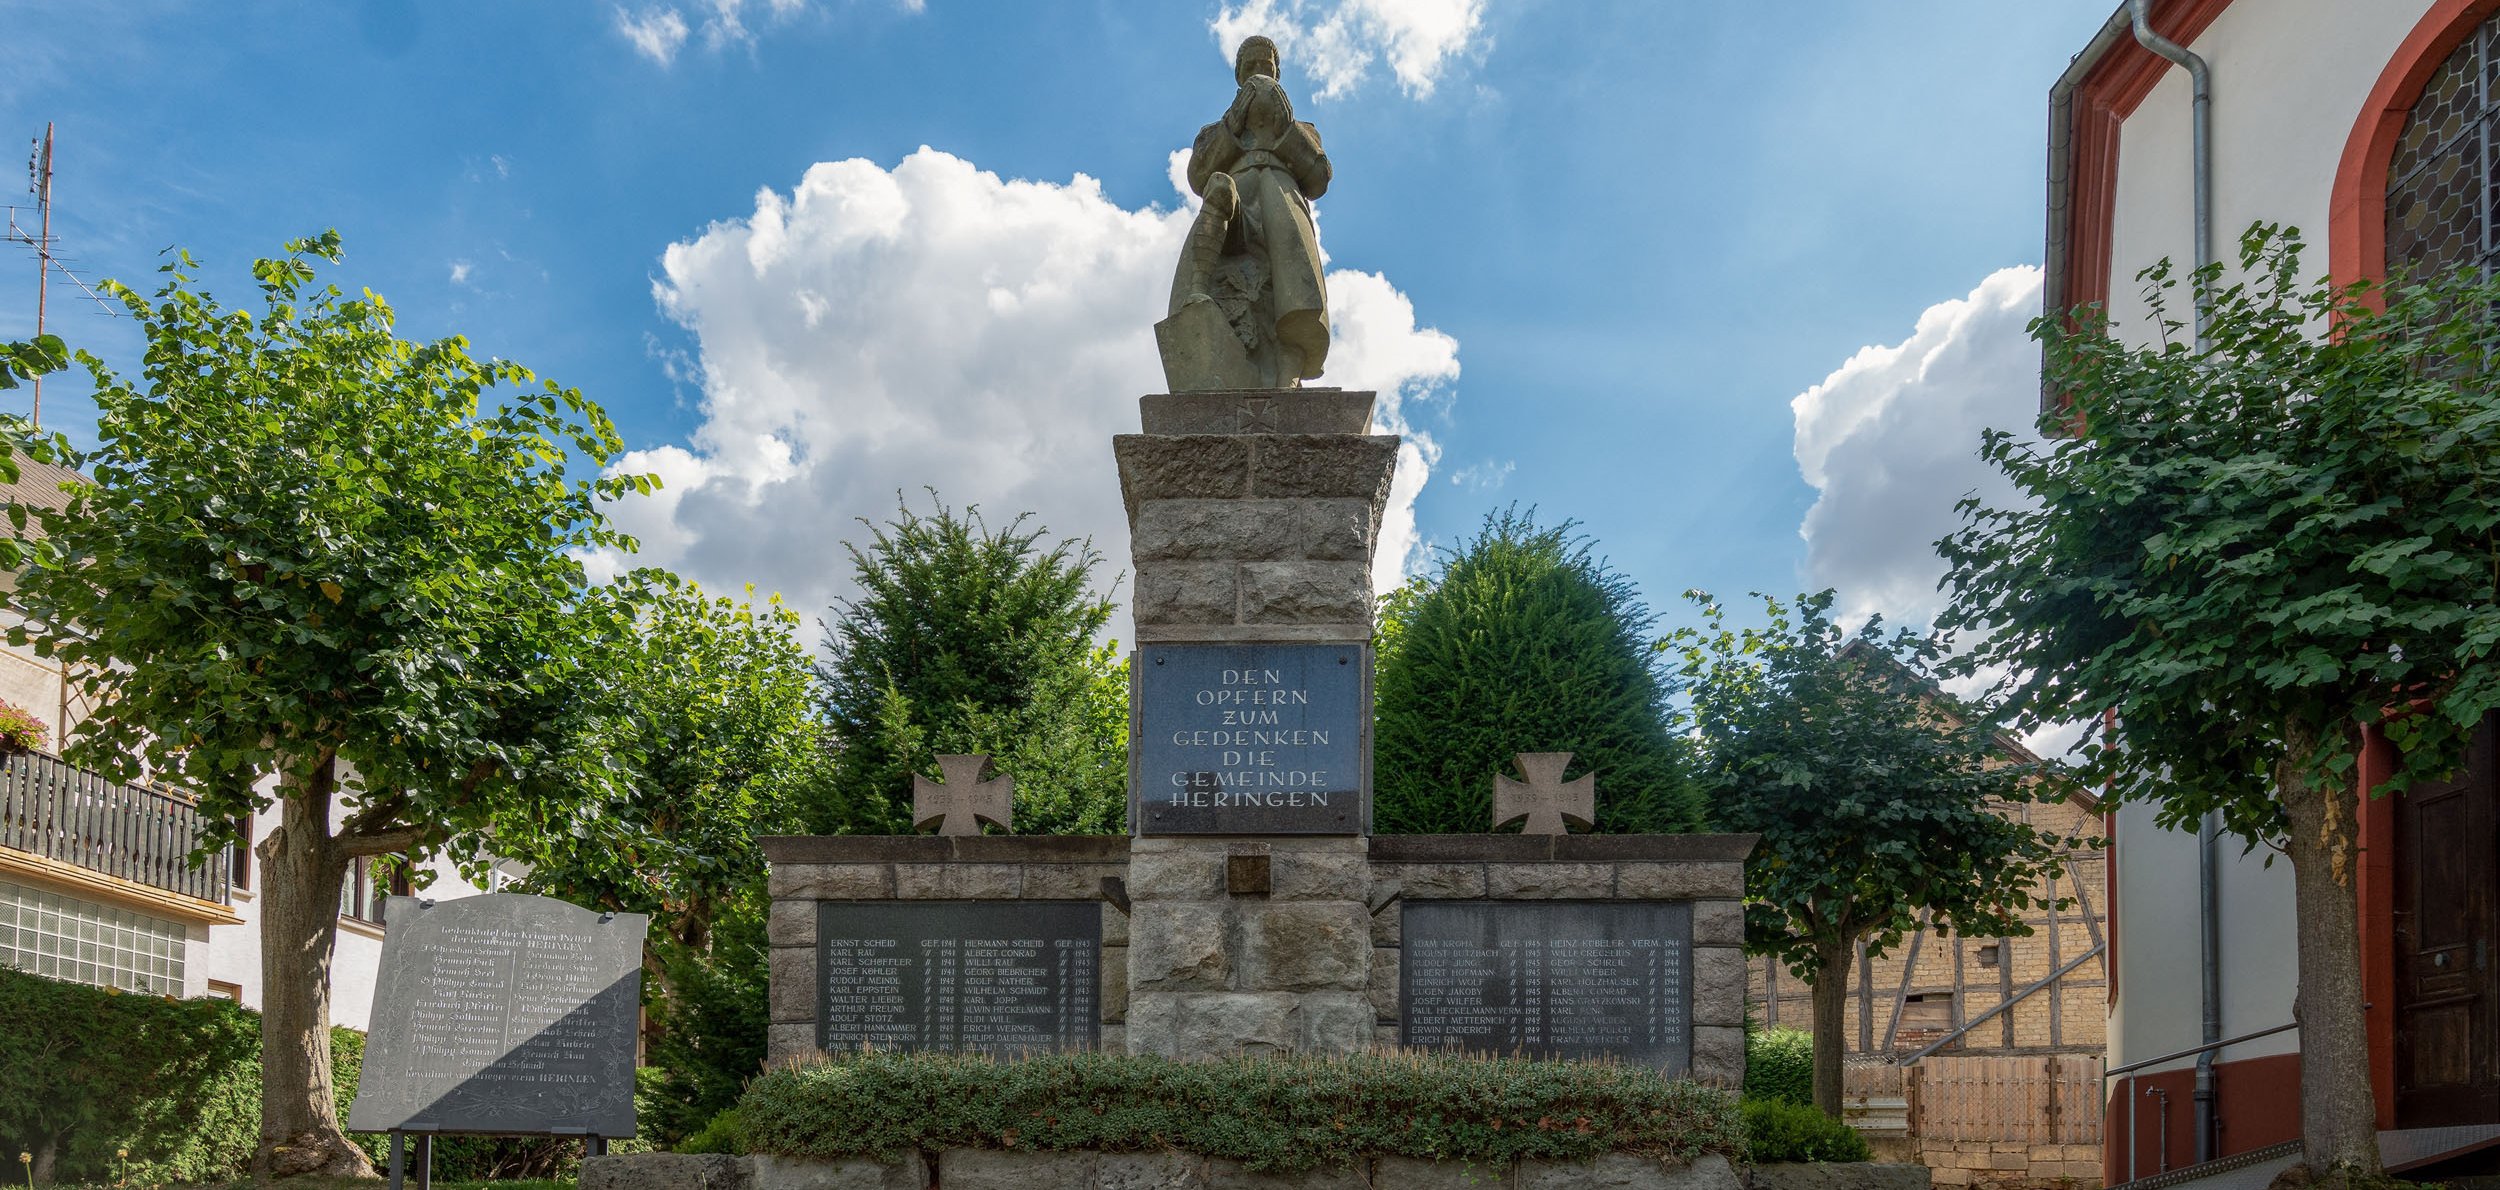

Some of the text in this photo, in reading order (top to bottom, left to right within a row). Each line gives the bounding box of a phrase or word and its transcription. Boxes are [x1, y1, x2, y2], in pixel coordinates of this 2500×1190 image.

[1222, 669, 1280, 685] DEN
[1196, 690, 1308, 706] OPFERN
[1222, 710, 1278, 726] ZUM
[1172, 730, 1329, 746] GEDENKEN
[1223, 750, 1275, 766] DIE
[1171, 771, 1328, 787] GEMEINDE
[1169, 792, 1328, 806] HERINGEN
[501, 929, 520, 940] der
[965, 949, 999, 957] ALBERT
[1001, 949, 1036, 957] CONRAD
[830, 958, 853, 966] KARL
[941, 958, 955, 966] 1941
[965, 968, 994, 976] GEORG
[998, 968, 1046, 976] BIEBRICHER
[830, 986, 852, 994] KARL
[856, 986, 899, 994] EPPSTEIN
[964, 996, 985, 1004] KARL
[994, 996, 1017, 1004] JOPP
[963, 1034, 994, 1042] PHILIPP
[997, 1034, 1052, 1042] DAUENHAUER
